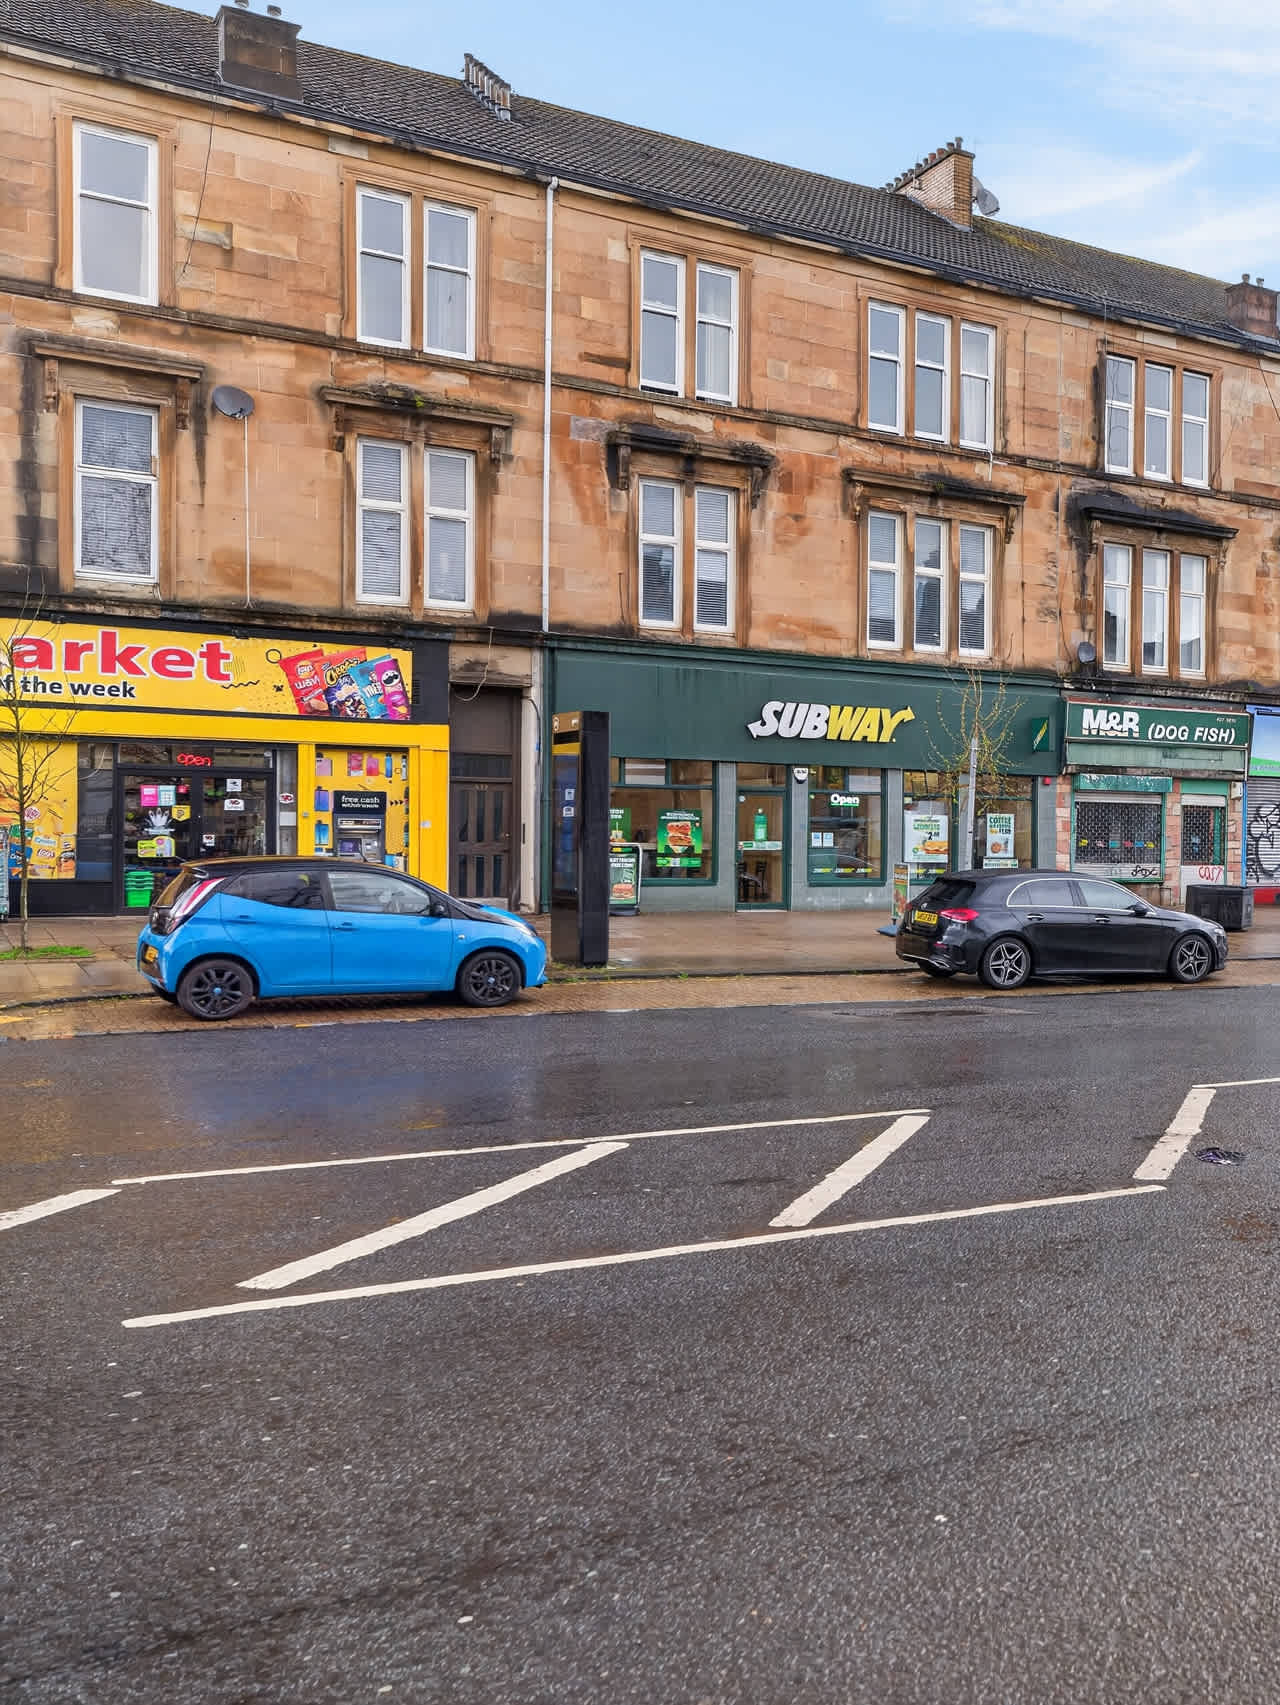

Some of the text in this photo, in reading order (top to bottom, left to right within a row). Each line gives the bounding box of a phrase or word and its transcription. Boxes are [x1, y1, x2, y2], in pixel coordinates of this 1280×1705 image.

[20, 675, 63, 694] the
[69, 680, 137, 698] week
[747, 701, 916, 743] SUBWAY
[1082, 708, 1140, 738] M&R
[1147, 723, 1236, 745] (DOG FISH)
[177, 753, 213, 767] open
[830, 793, 860, 804] Open
